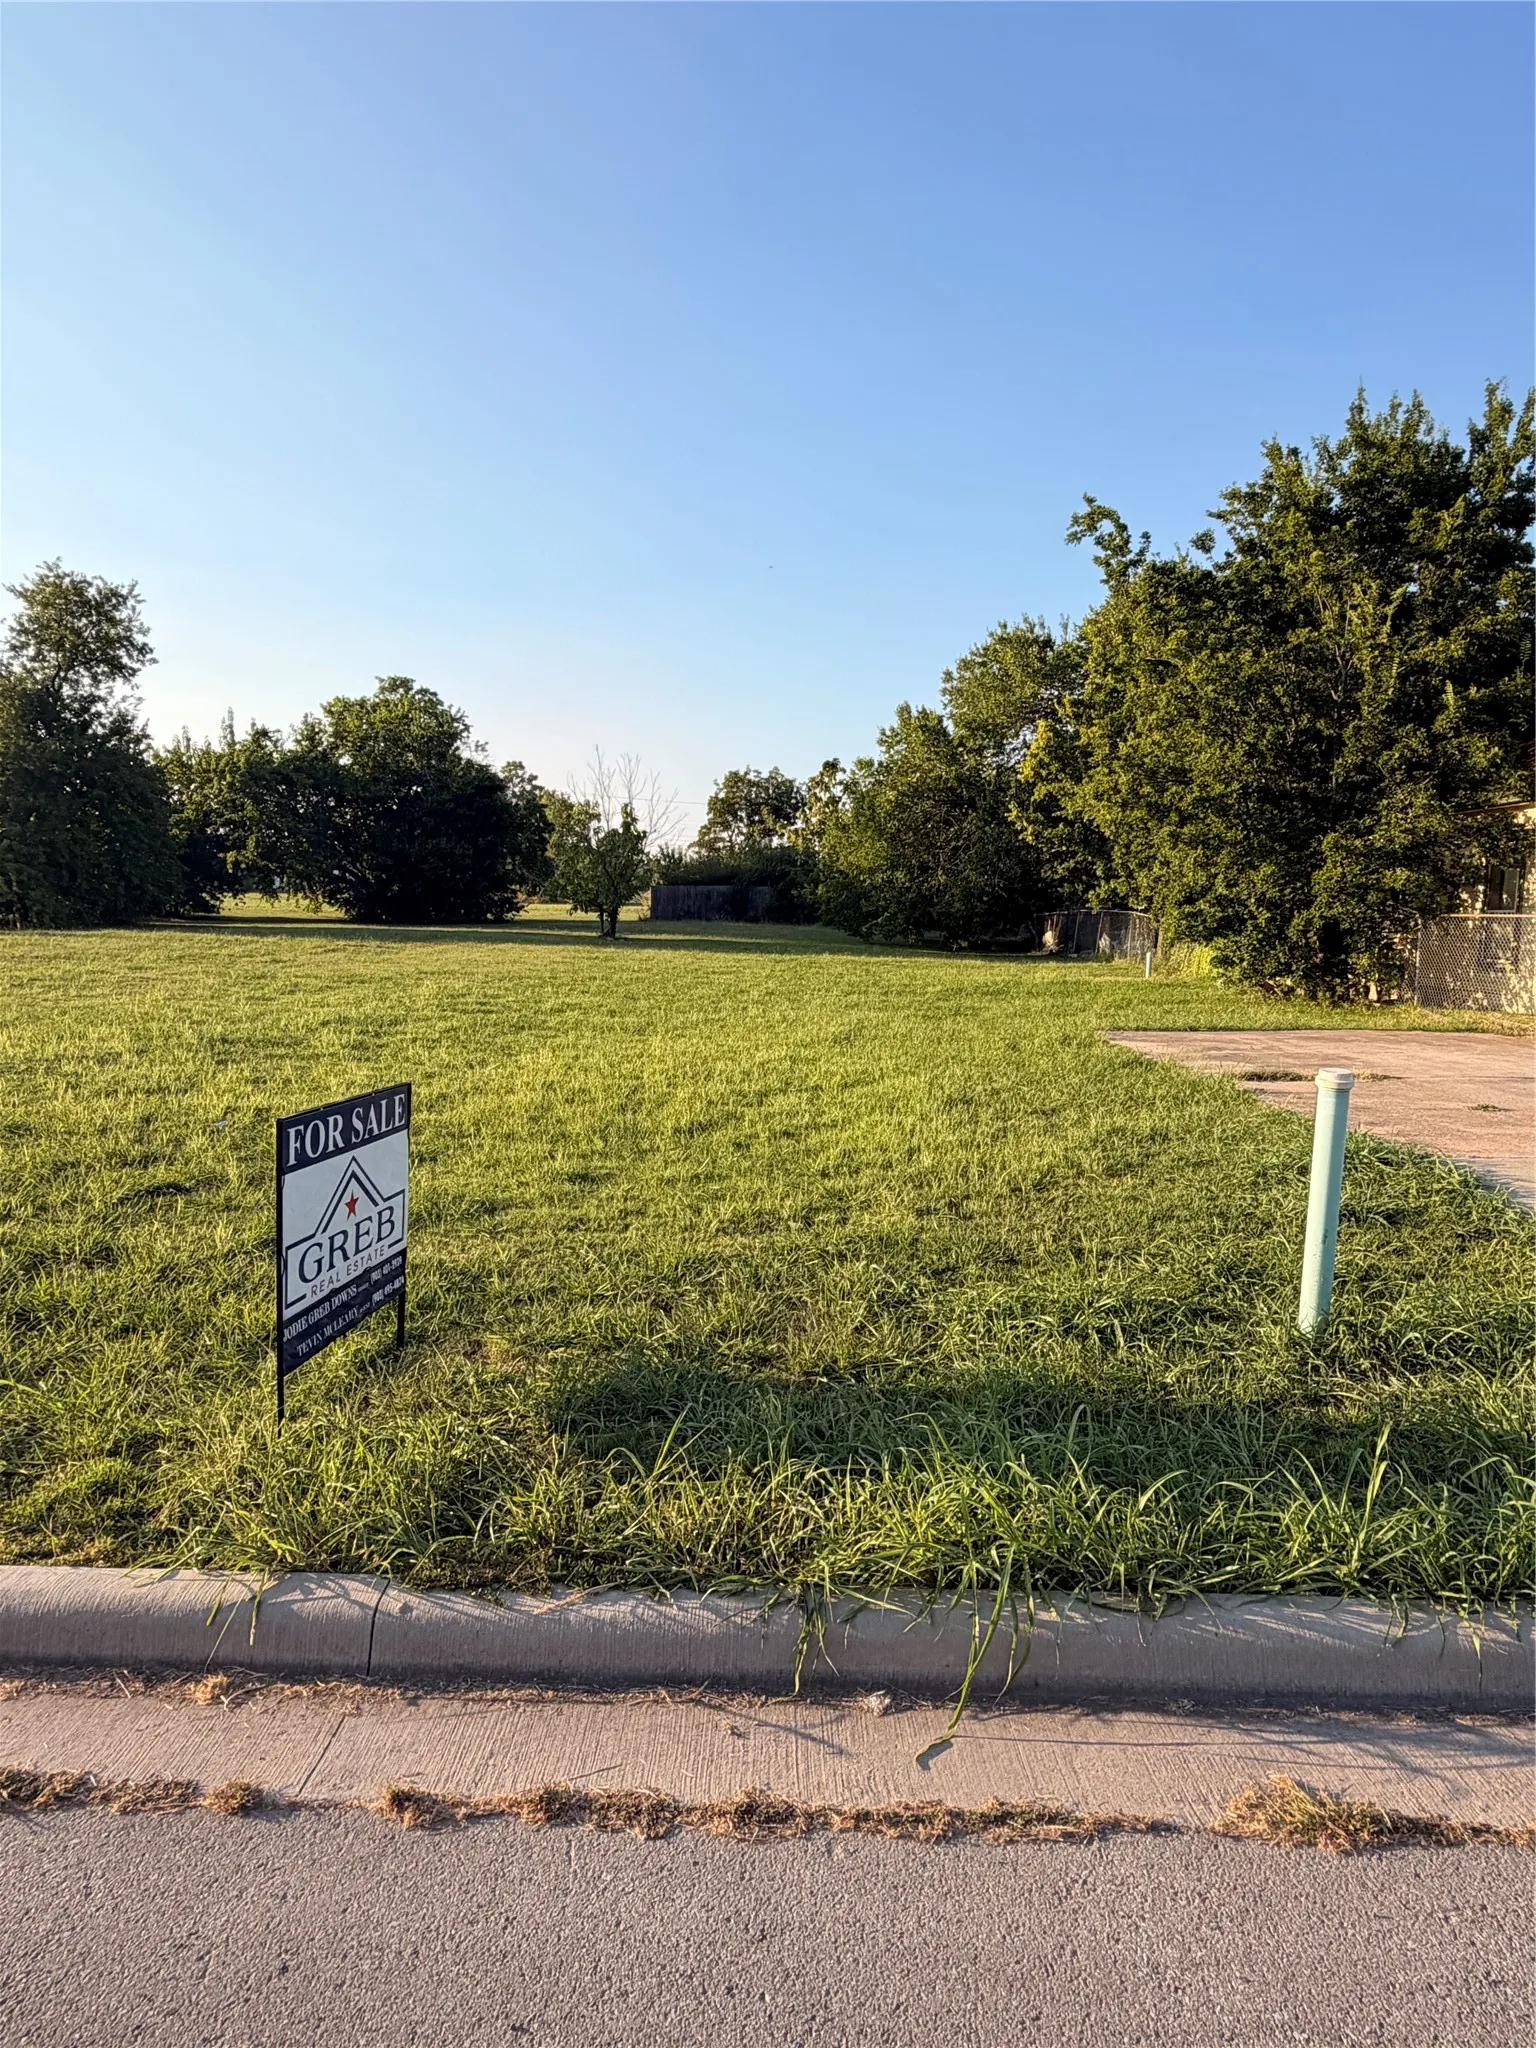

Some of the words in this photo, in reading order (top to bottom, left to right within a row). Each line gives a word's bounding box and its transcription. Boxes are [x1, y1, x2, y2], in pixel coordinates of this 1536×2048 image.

[286, 1114, 345, 1167] FOR
[351, 1093, 405, 1144] SALE
[298, 1205, 395, 1284] GREB
[310, 1272, 341, 1298] REAL
[346, 1244, 385, 1276] ESTATE
[283, 1315, 308, 1343] JODIE
[308, 1301, 330, 1325] GREB
[331, 1284, 357, 1310] DOWNS
